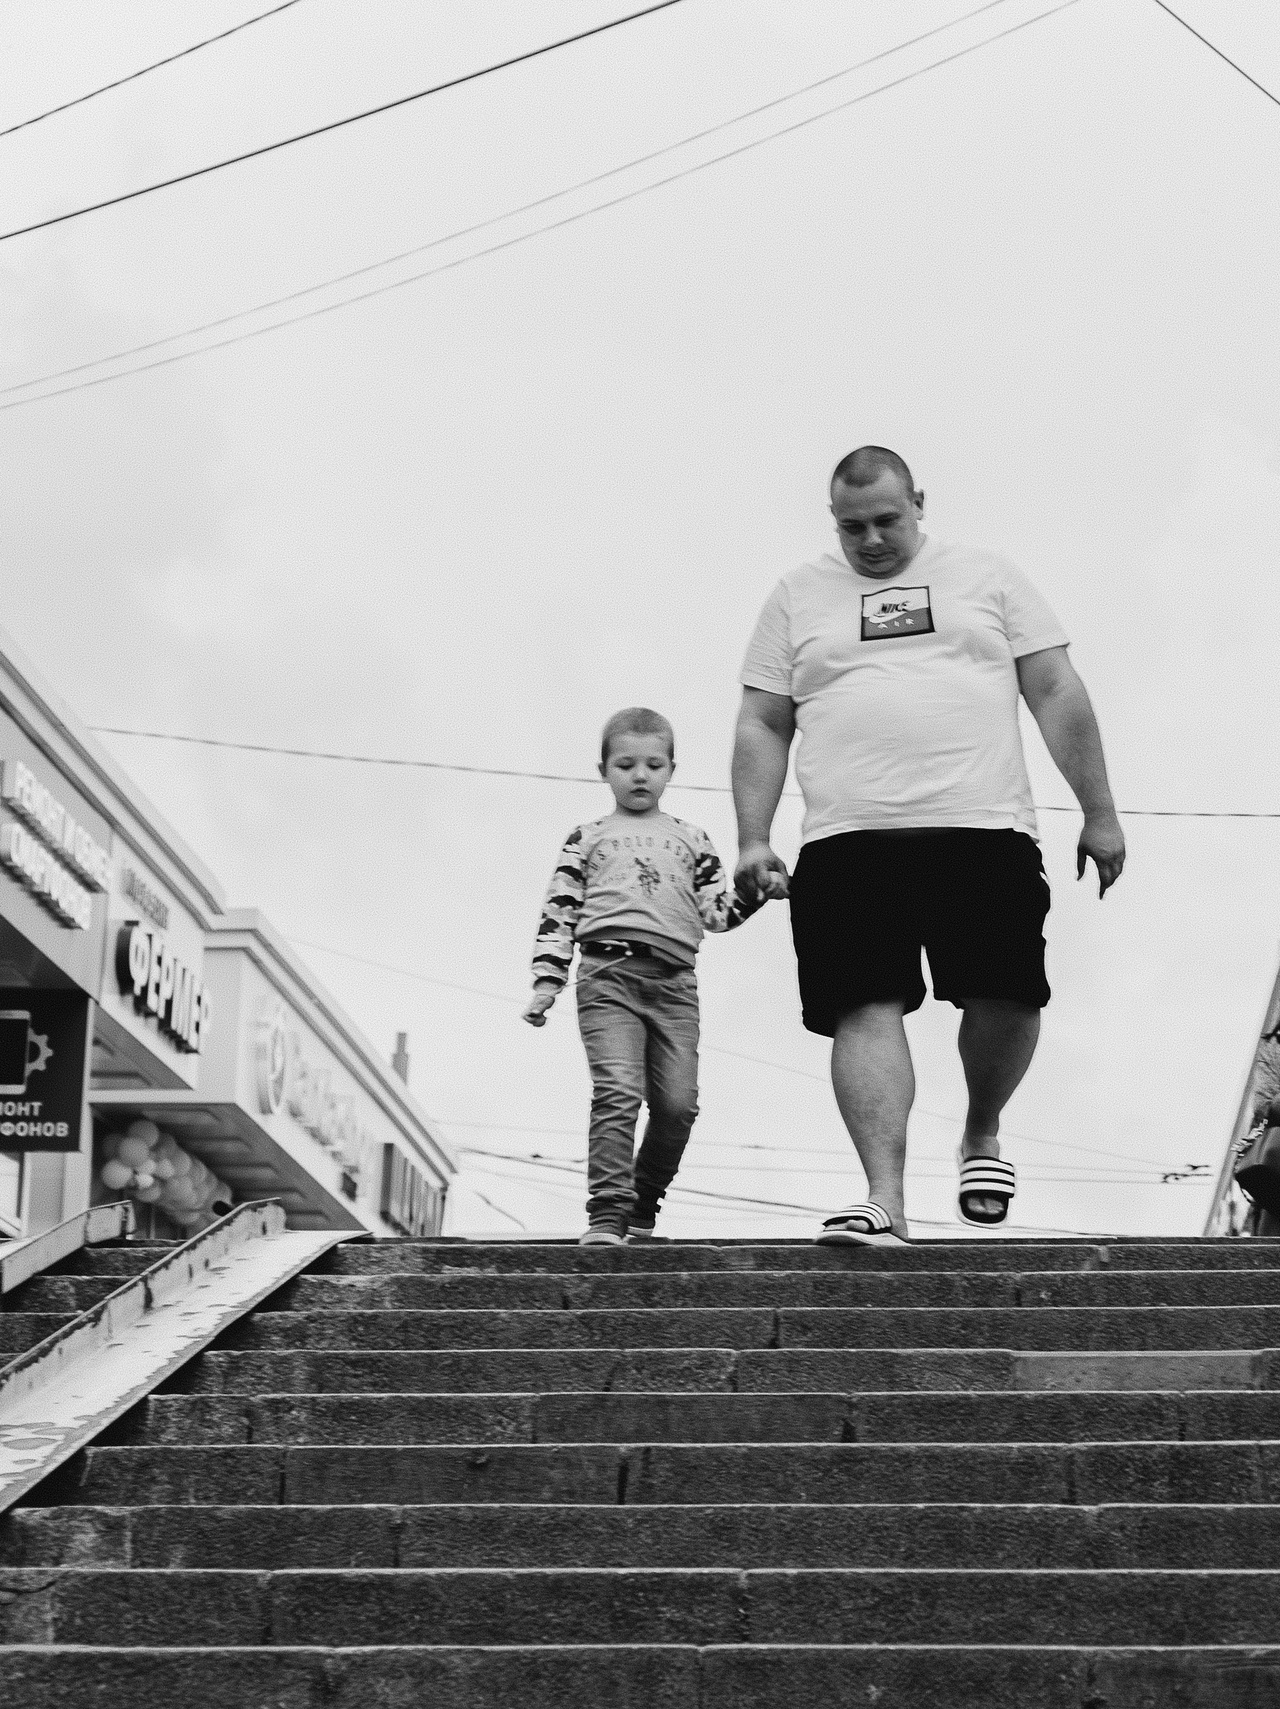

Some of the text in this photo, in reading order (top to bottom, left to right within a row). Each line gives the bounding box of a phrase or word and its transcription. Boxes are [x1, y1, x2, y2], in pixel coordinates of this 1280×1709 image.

[124, 918, 211, 1052] ФЕРМЕР
[0, 1101, 42, 1116] ОНТ
[0, 1121, 69, 1137] ФОНОВ
